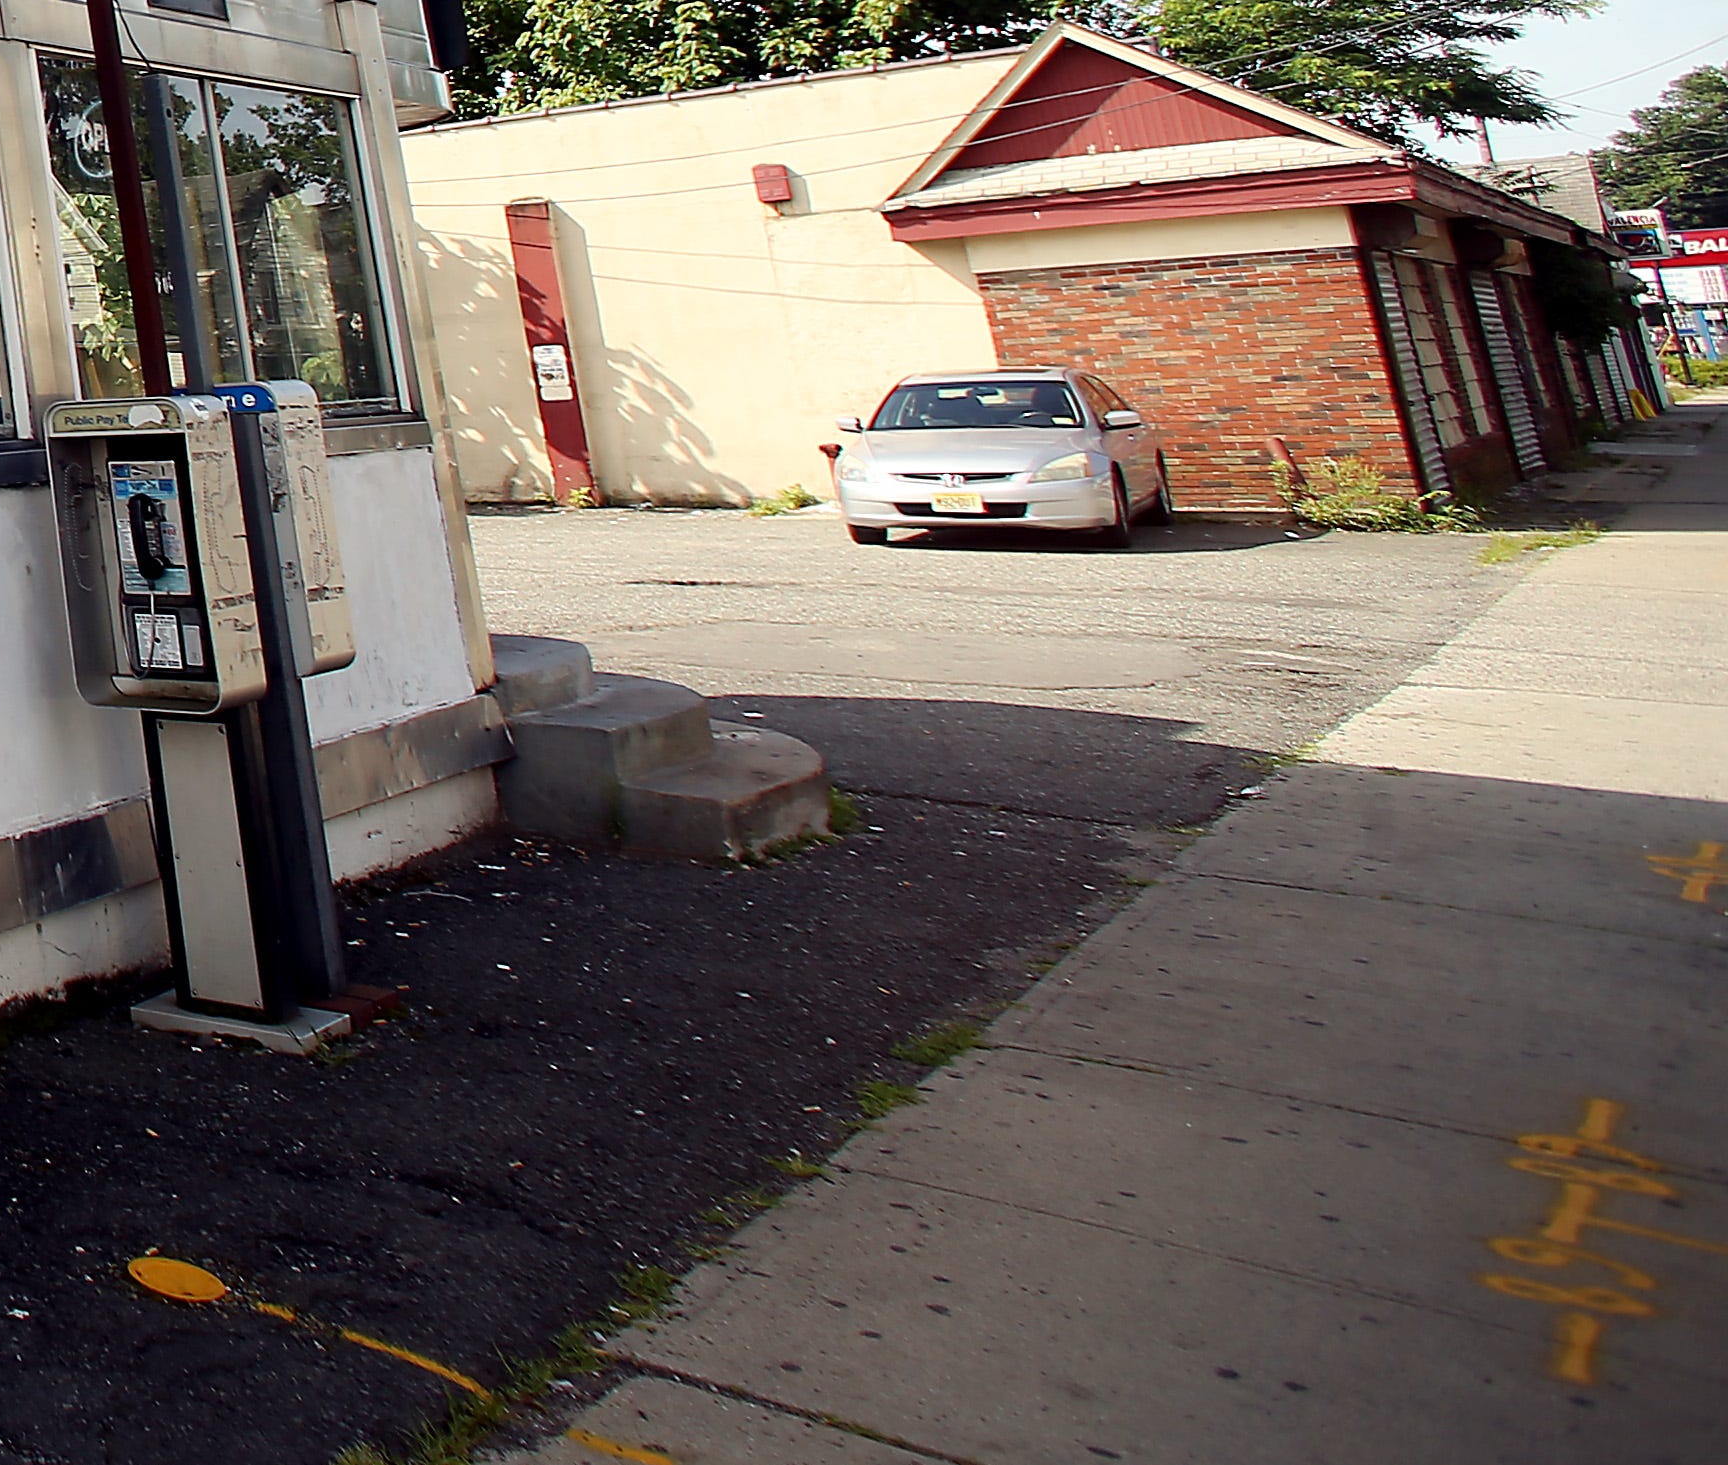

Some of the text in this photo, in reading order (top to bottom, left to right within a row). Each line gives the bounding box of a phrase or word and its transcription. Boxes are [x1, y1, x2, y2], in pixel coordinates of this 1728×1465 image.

[1683, 237, 1728, 254] BAL
[64, 415, 94, 425] Public
[96, 415, 115, 427] Pay
